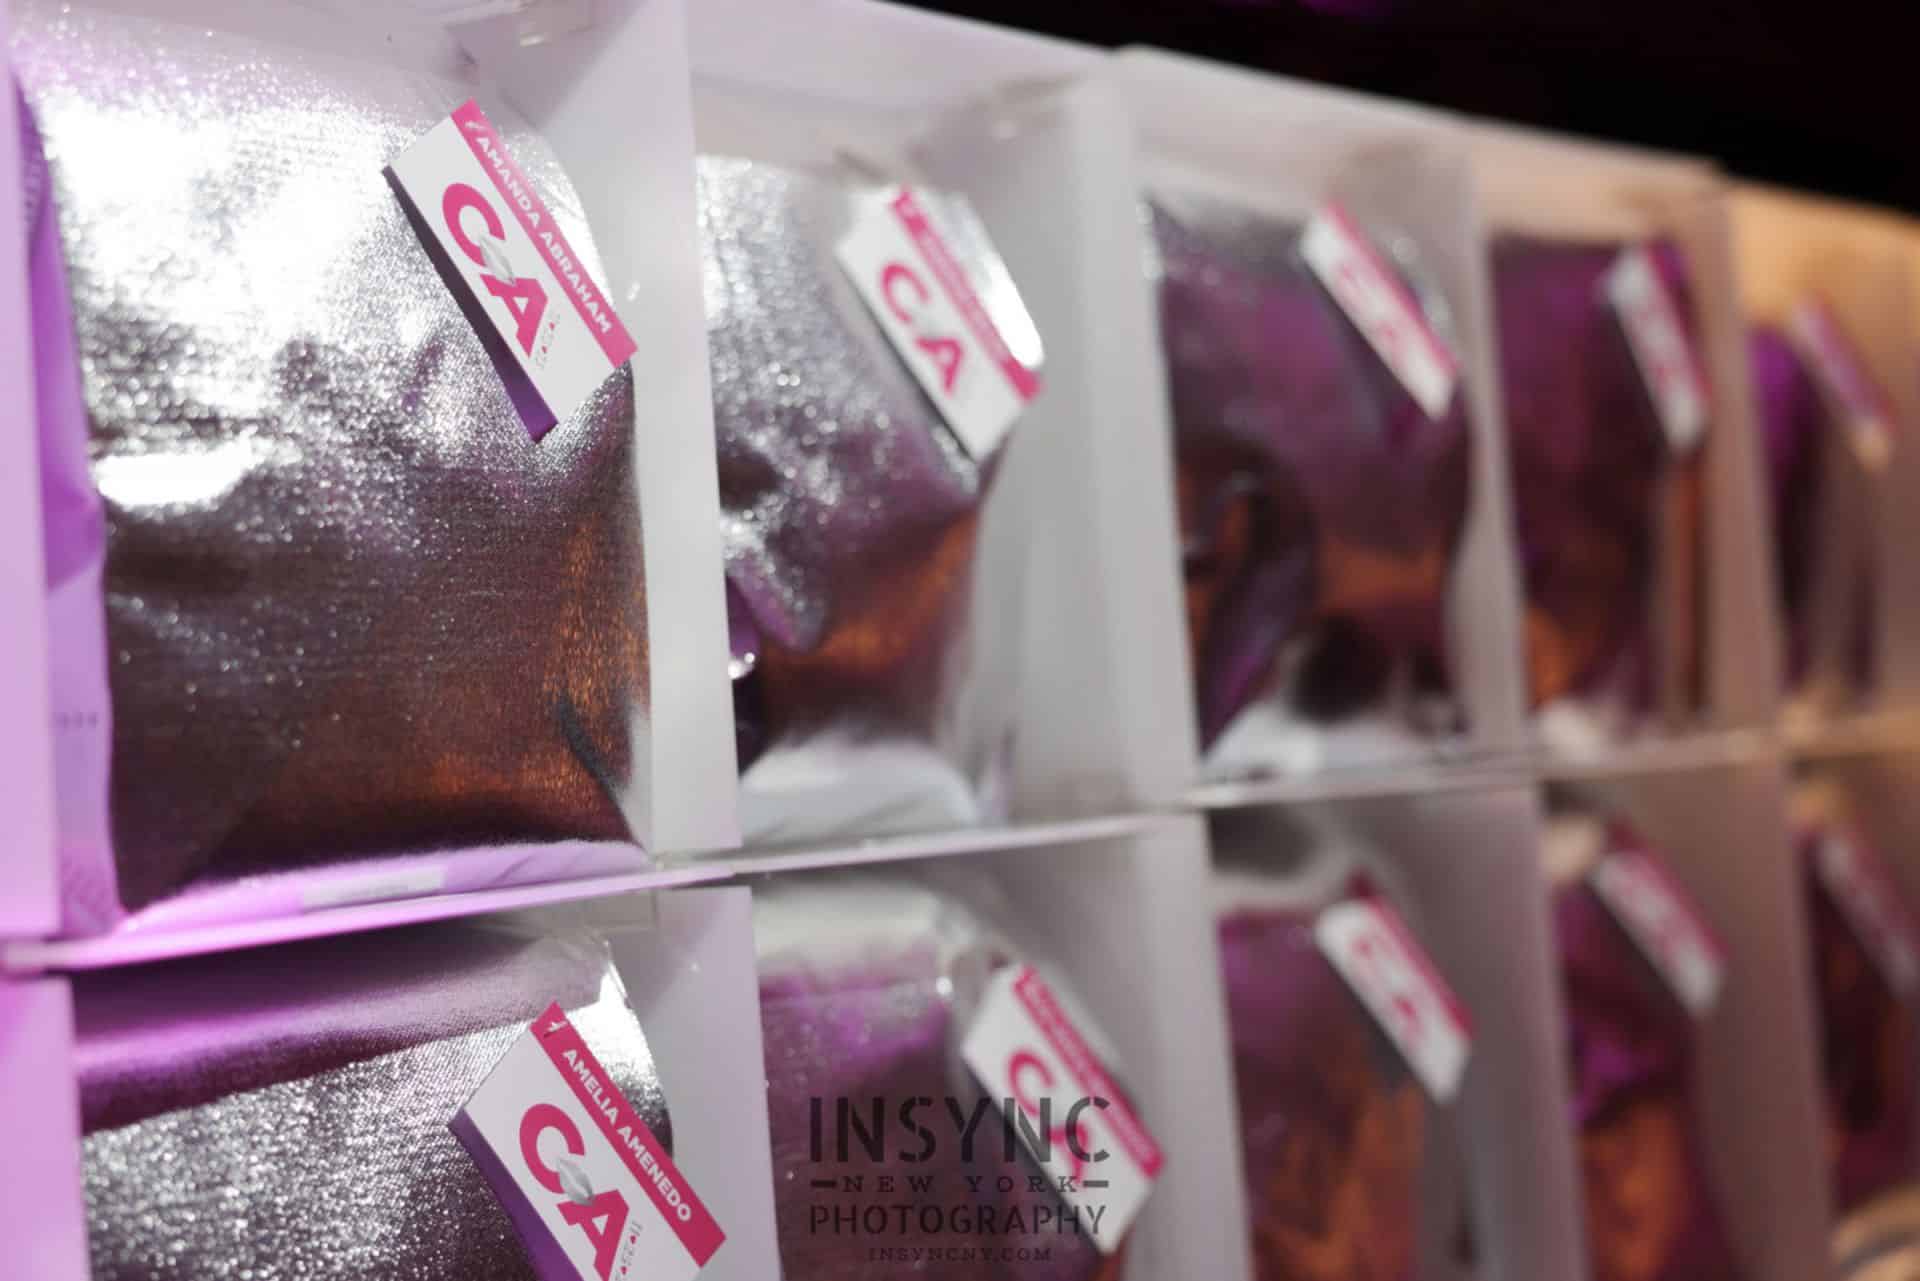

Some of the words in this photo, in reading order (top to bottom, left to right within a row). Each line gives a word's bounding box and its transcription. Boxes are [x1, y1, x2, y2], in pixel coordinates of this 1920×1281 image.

[476, 135, 541, 230] AMANDA
[540, 230, 614, 334] ABRAHAM
[563, 1048, 620, 1126] AMELIA
[618, 1125, 693, 1223] AMENEDO
